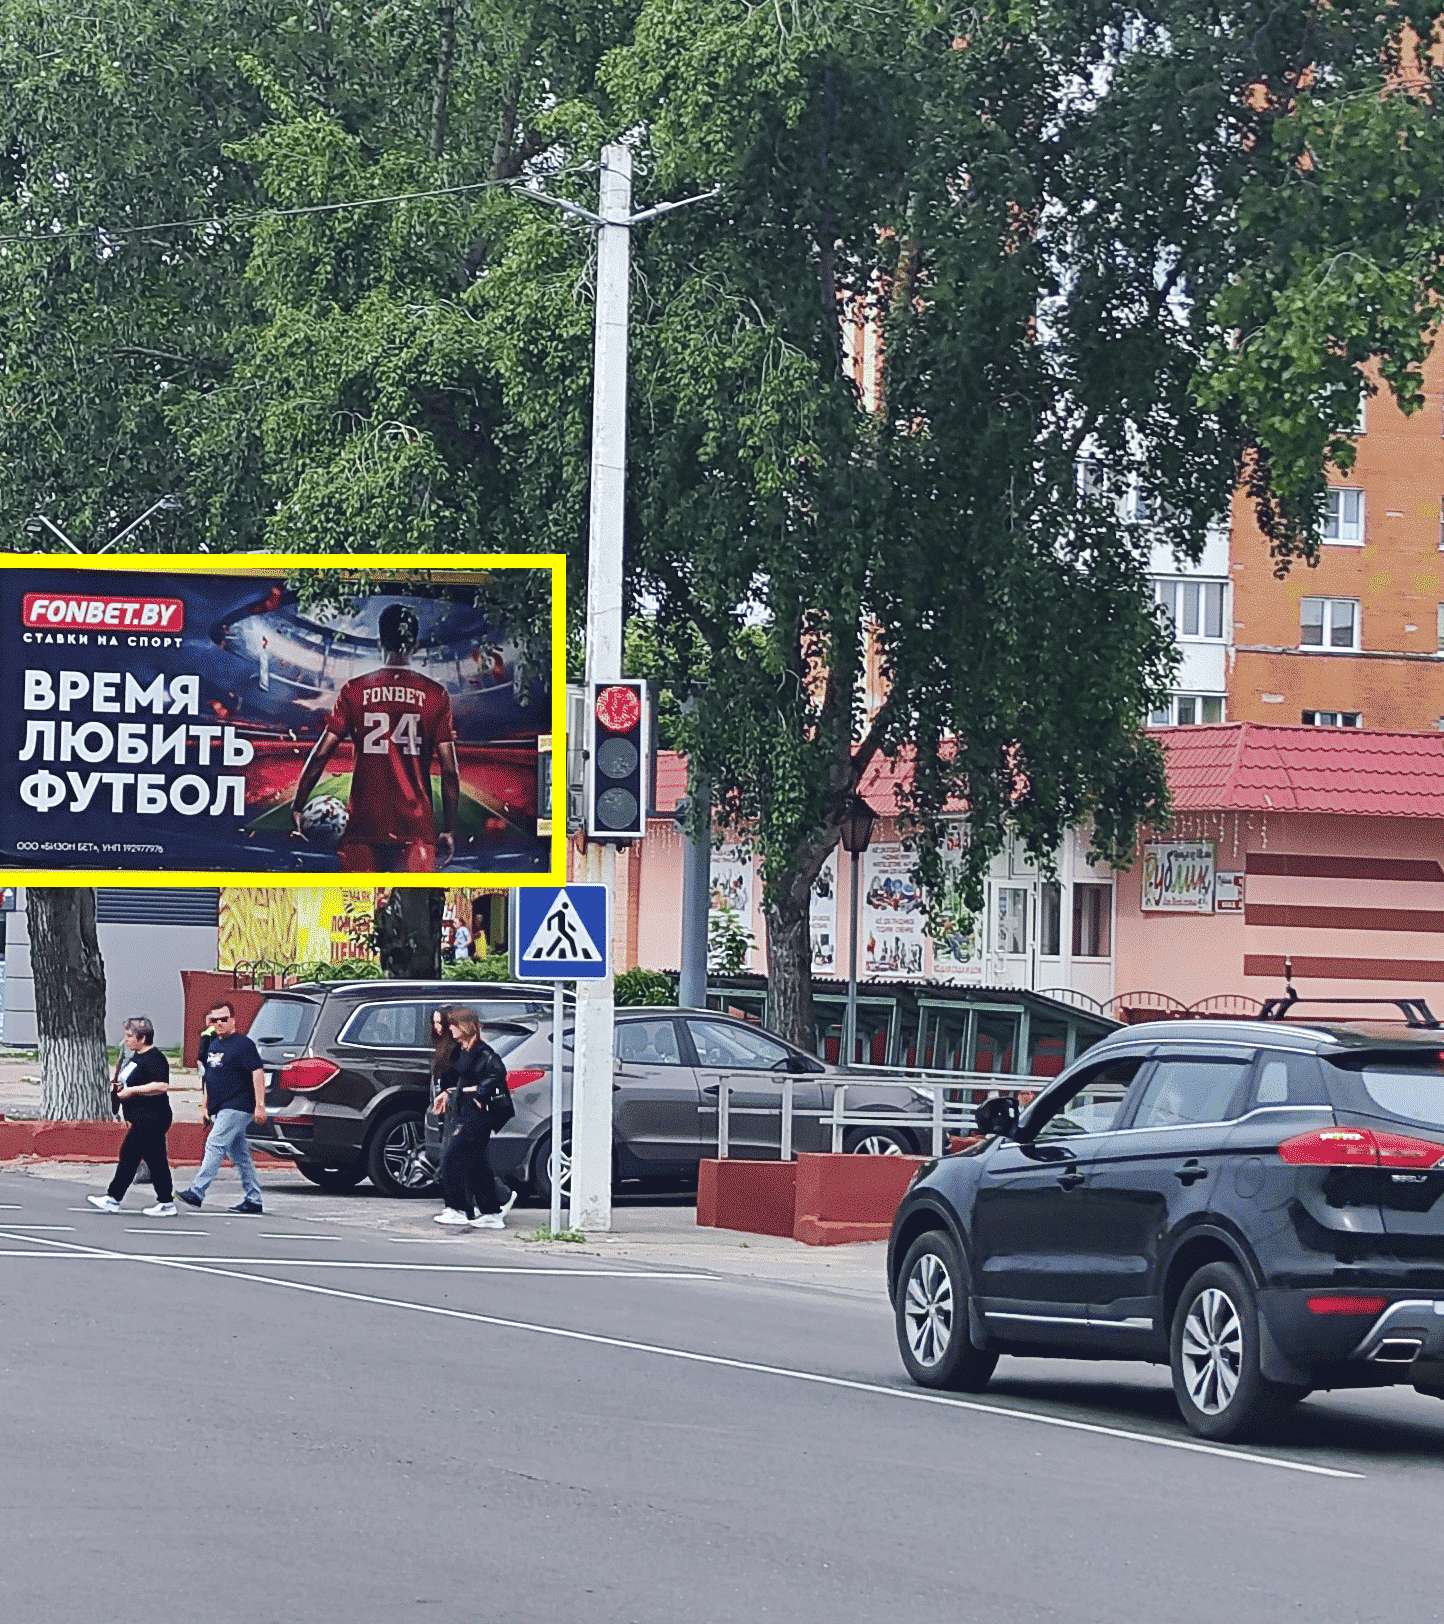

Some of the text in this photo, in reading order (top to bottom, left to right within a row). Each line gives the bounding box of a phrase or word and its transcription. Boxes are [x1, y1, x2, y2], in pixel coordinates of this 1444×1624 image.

[29, 599, 177, 626] FONBET.BY
[22, 632, 183, 648] СТАВКИ НА СПОРТ
[23, 669, 200, 715] ВРЕМЯ
[362, 686, 426, 707] FONBET
[18, 719, 255, 766] ЛЮБИТЬ
[362, 712, 423, 756] 24
[19, 769, 246, 816] ФУТБОЛ
[16, 841, 39, 851] ООО
[102, 843, 121, 852] УНП
